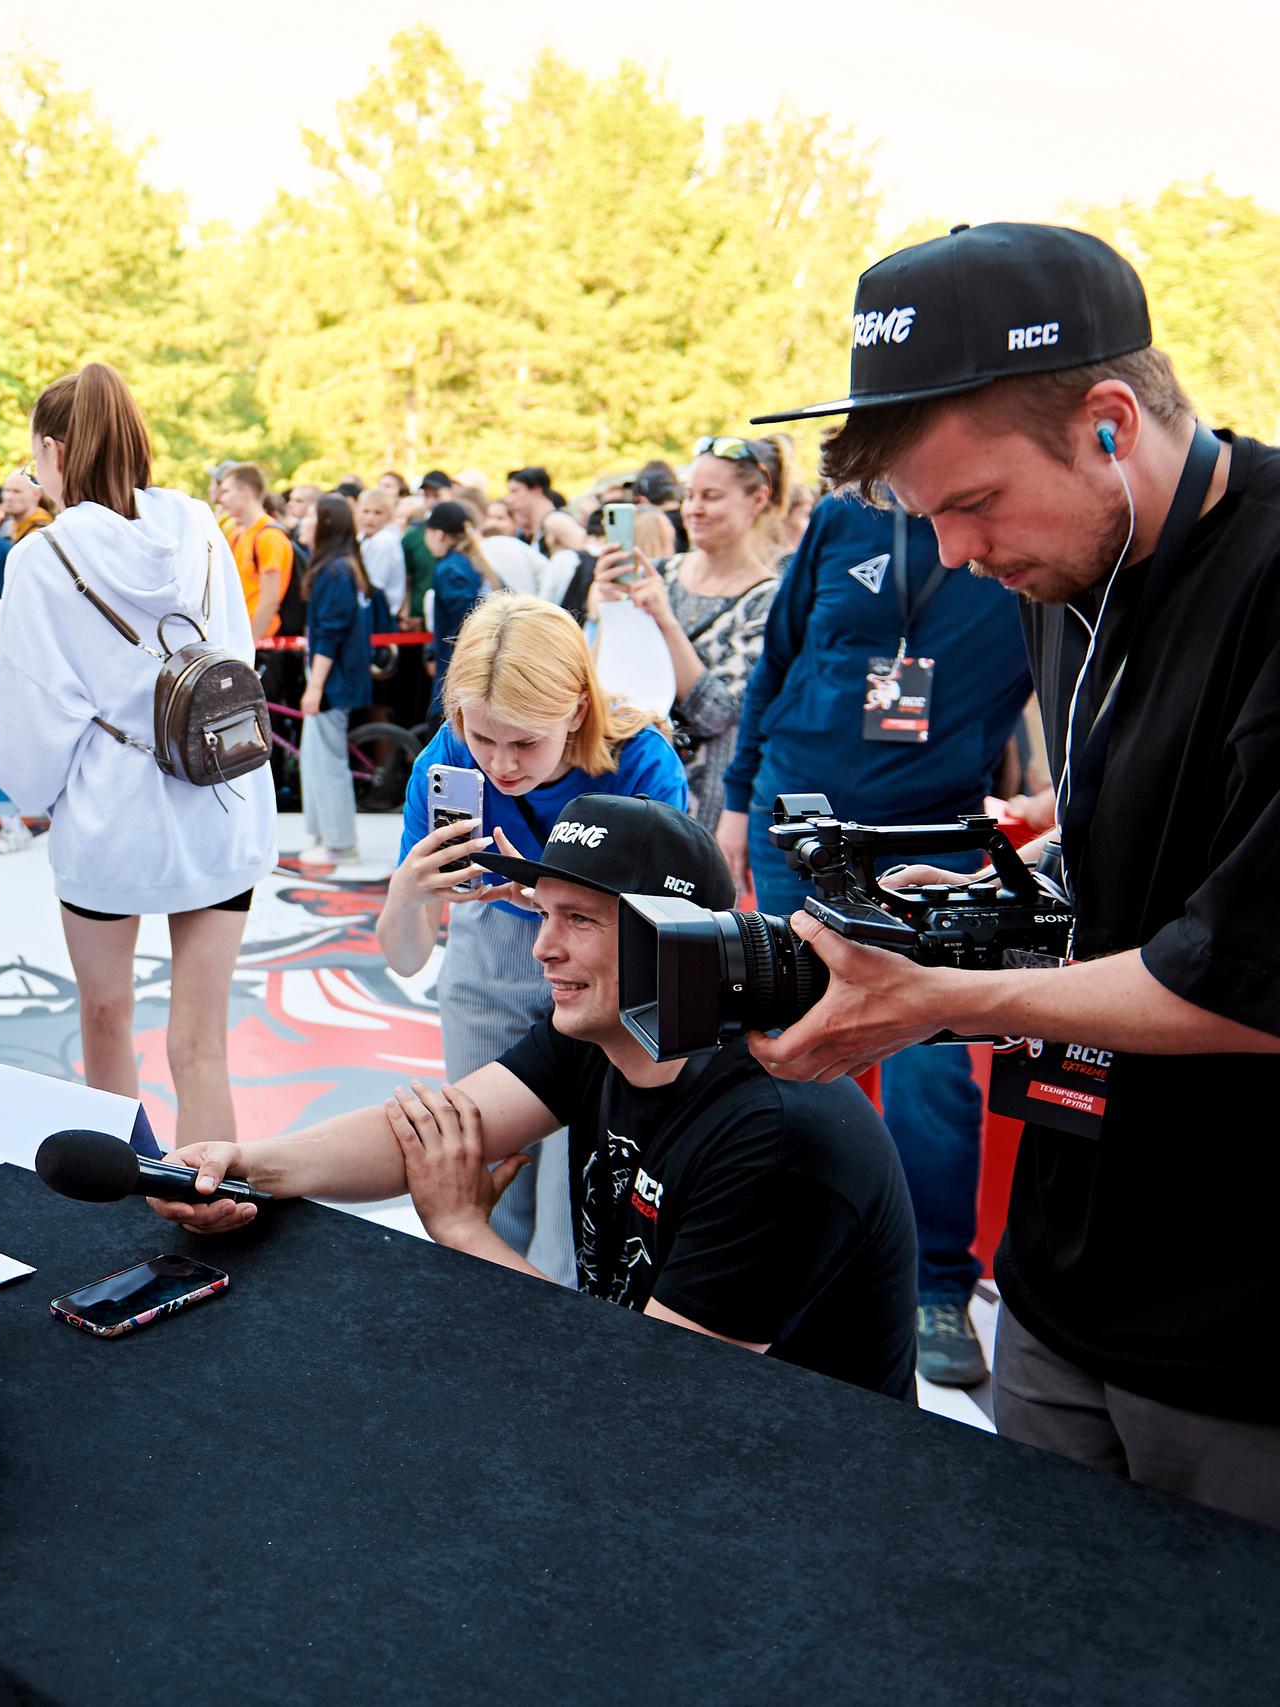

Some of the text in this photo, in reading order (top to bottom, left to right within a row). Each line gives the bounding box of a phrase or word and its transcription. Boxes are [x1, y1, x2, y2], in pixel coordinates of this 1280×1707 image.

[853, 306, 917, 349] REME
[1008, 322, 1059, 350] RCC
[549, 821, 609, 848] TREME
[663, 875, 695, 896] RCC
[1033, 913, 1073, 923] SON
[732, 983, 743, 992] G
[1065, 1043, 1114, 1068] RCC
[1061, 1060, 1110, 1080] EXTREME
[1039, 1083, 1094, 1104] ТЕХНИЧЕСКАЯ
[1061, 1097, 1093, 1111] ГРУППА
